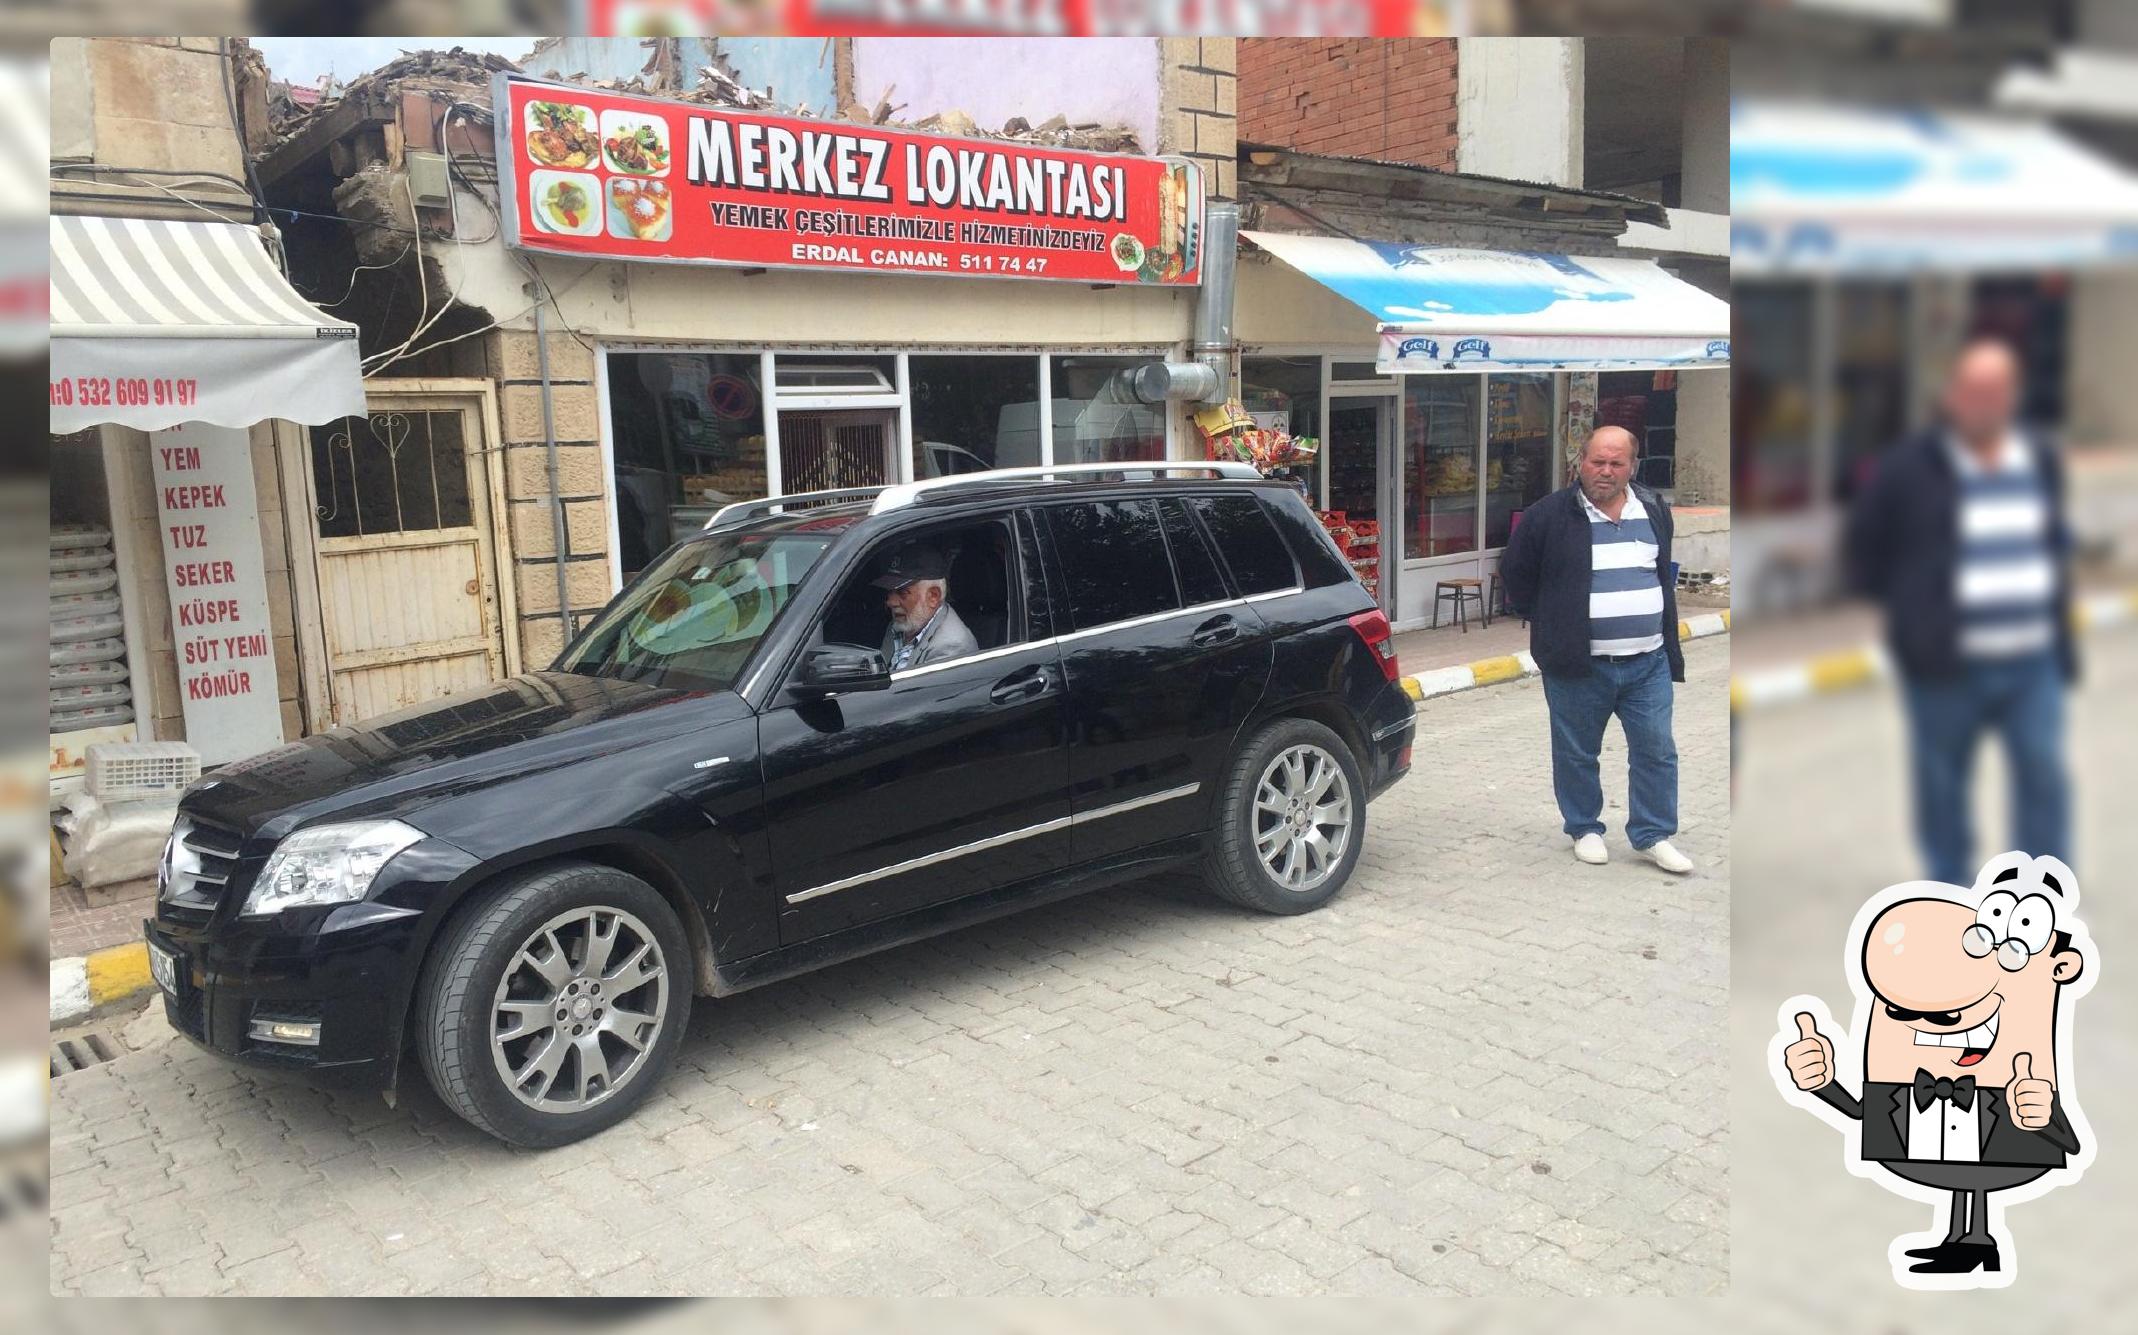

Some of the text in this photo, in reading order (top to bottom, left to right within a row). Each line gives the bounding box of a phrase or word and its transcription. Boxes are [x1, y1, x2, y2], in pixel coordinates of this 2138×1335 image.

[687, 116, 1126, 222] MERKEZ LOKANTASI
[710, 202, 1105, 252] YEMEK ÇEŞİTLERİMİZLE HİZMETİNİZDEYİZ
[792, 243, 1048, 273] ERDAL CANAN: 511 74 47
[78, 378, 111, 406] 532
[116, 378, 149, 406] 609
[153, 378, 173, 406] 91
[178, 378, 197, 406] 97
[160, 447, 201, 471] YEM
[164, 485, 226, 509] KEPEK
[170, 525, 207, 549] TUZ
[175, 561, 235, 587] SEKER
[179, 598, 240, 627] KÜSPE
[184, 629, 268, 664] SÜT YEMİ
[188, 669, 251, 700] KÖMÜR
